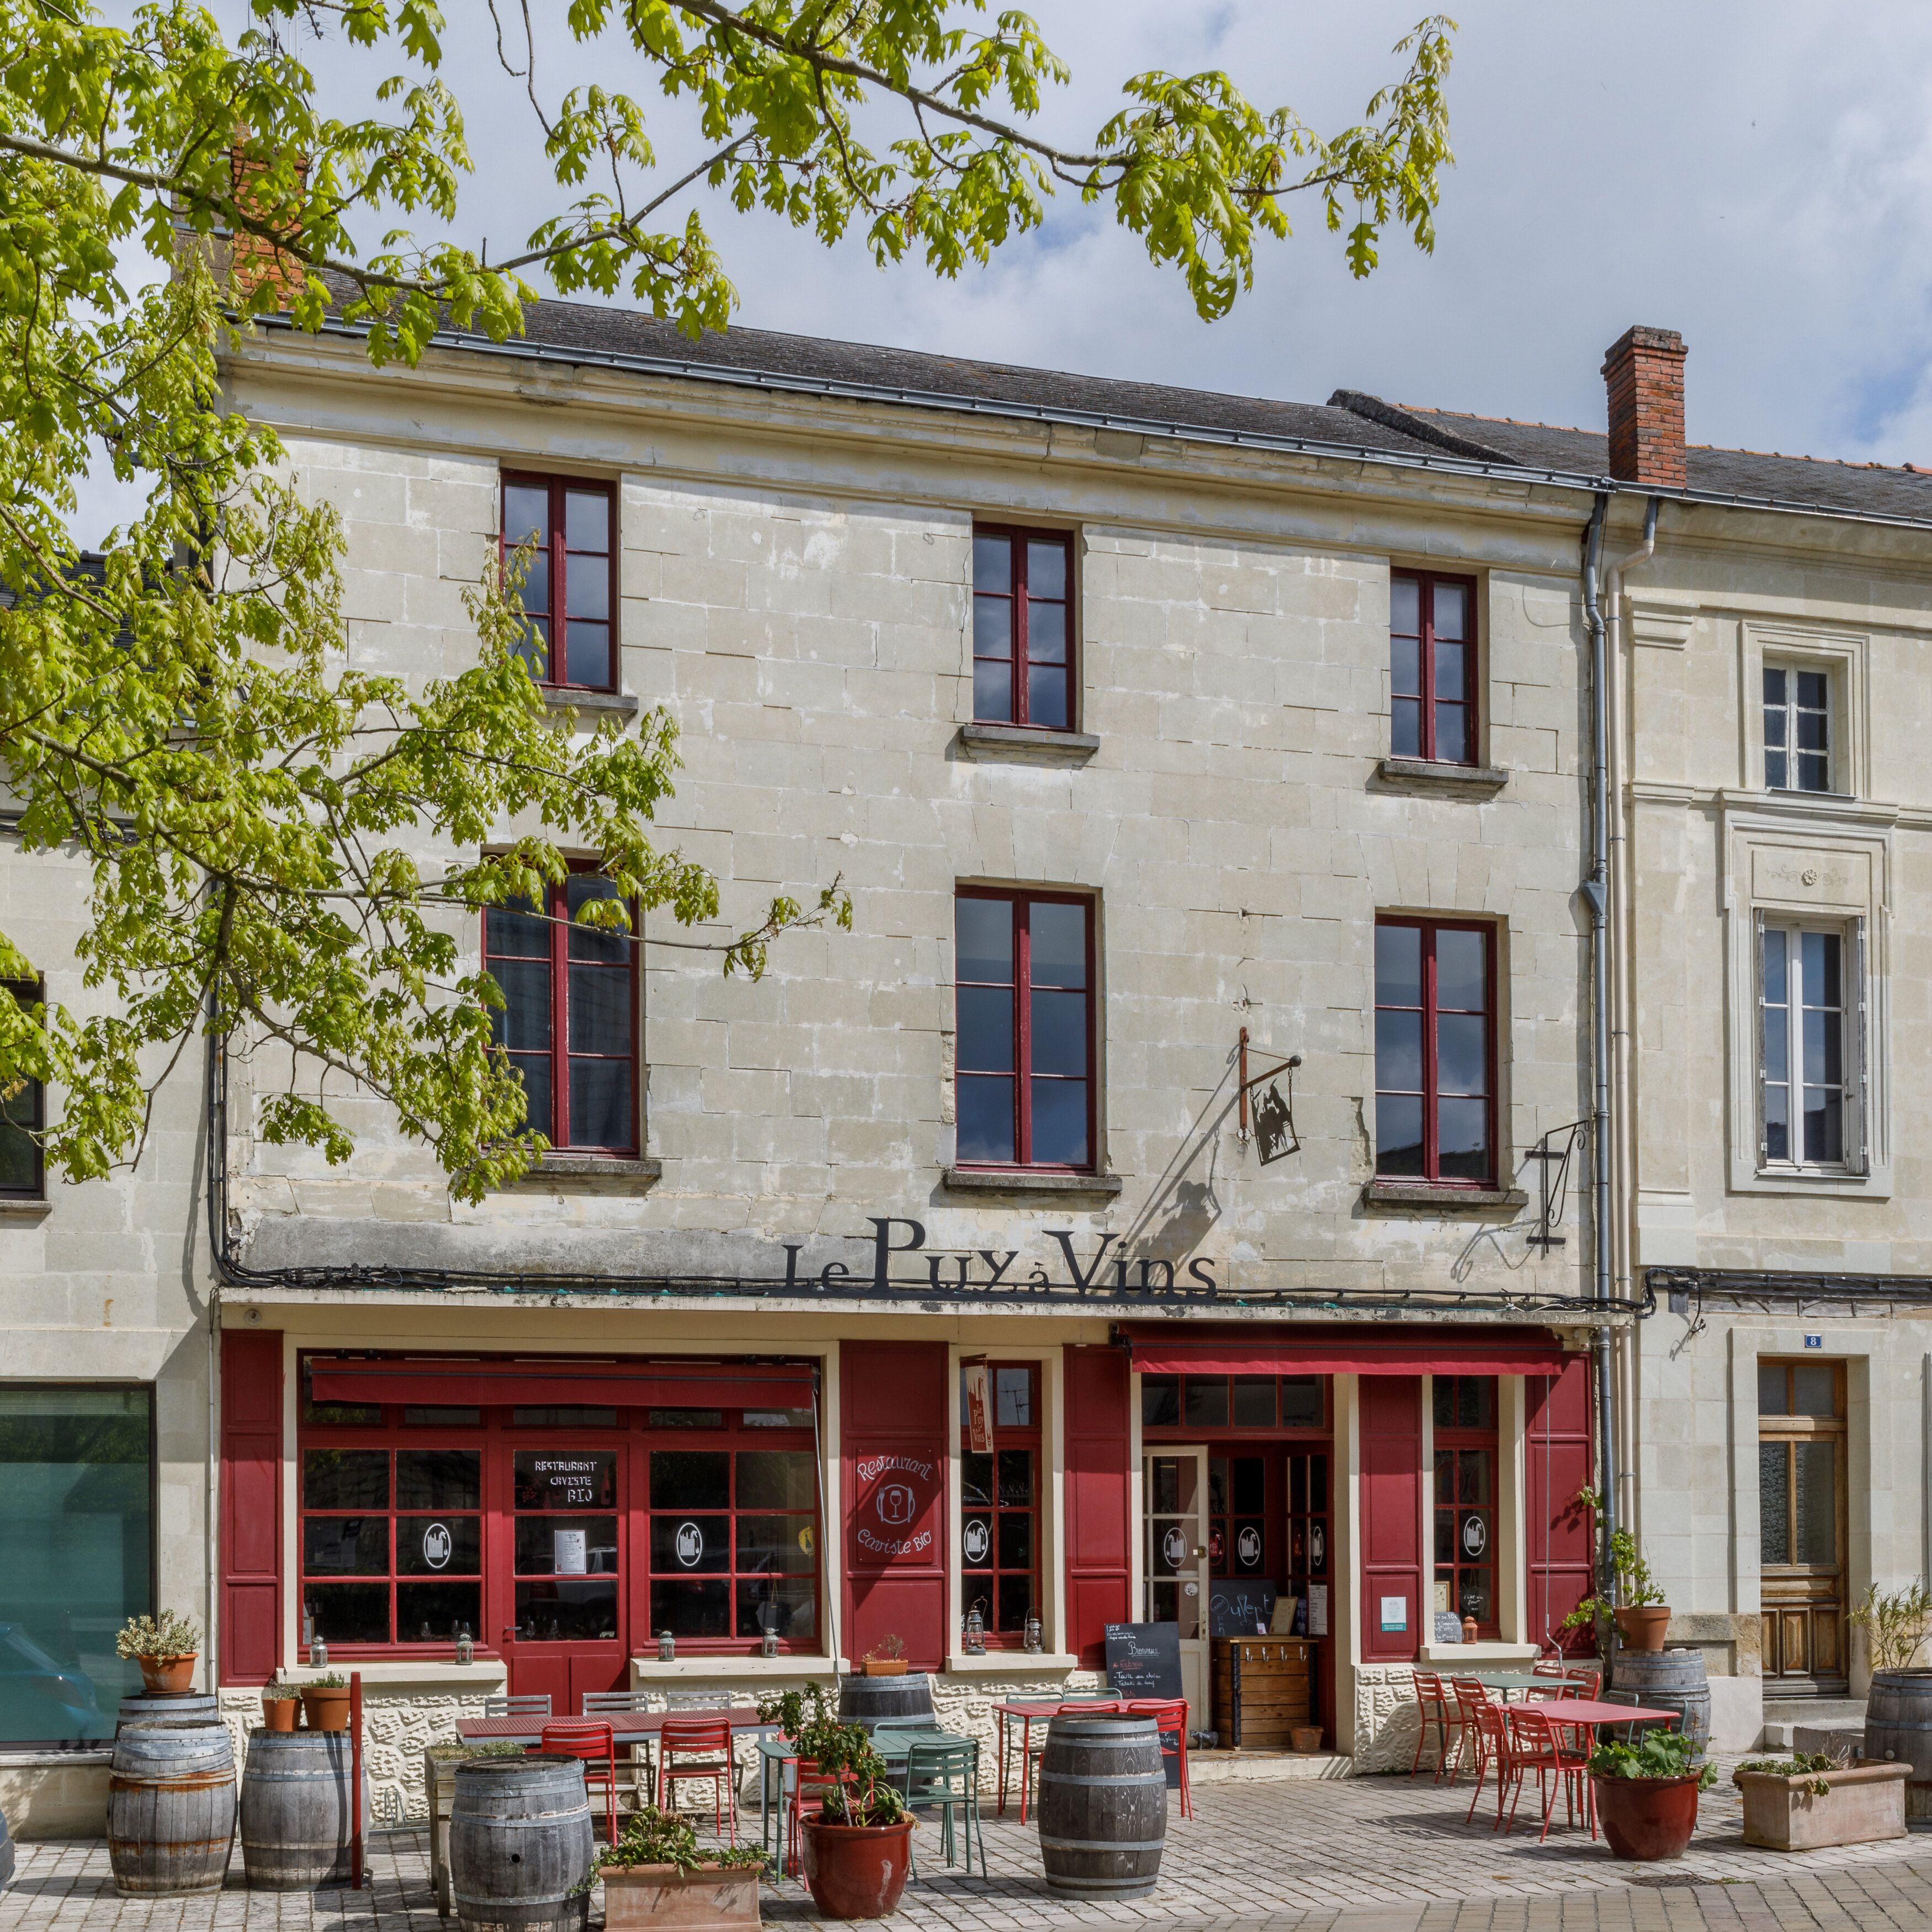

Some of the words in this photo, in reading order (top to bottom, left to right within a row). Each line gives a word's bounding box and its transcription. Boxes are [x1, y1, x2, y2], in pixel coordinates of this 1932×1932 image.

[781, 1244, 850, 1291] Le
[866, 1217, 1019, 1294] Puy
[1028, 1262, 1052, 1294] à
[1042, 1230, 1216, 1298] Vins
[1811, 1337, 1817, 1346] 8
[535, 1461, 597, 1471] RESTAURANT
[857, 1456, 933, 1481] Restaurant
[550, 1477, 592, 1485] CAVISTE
[567, 1489, 592, 1502] BIO
[858, 1529, 911, 1554] Caviste
